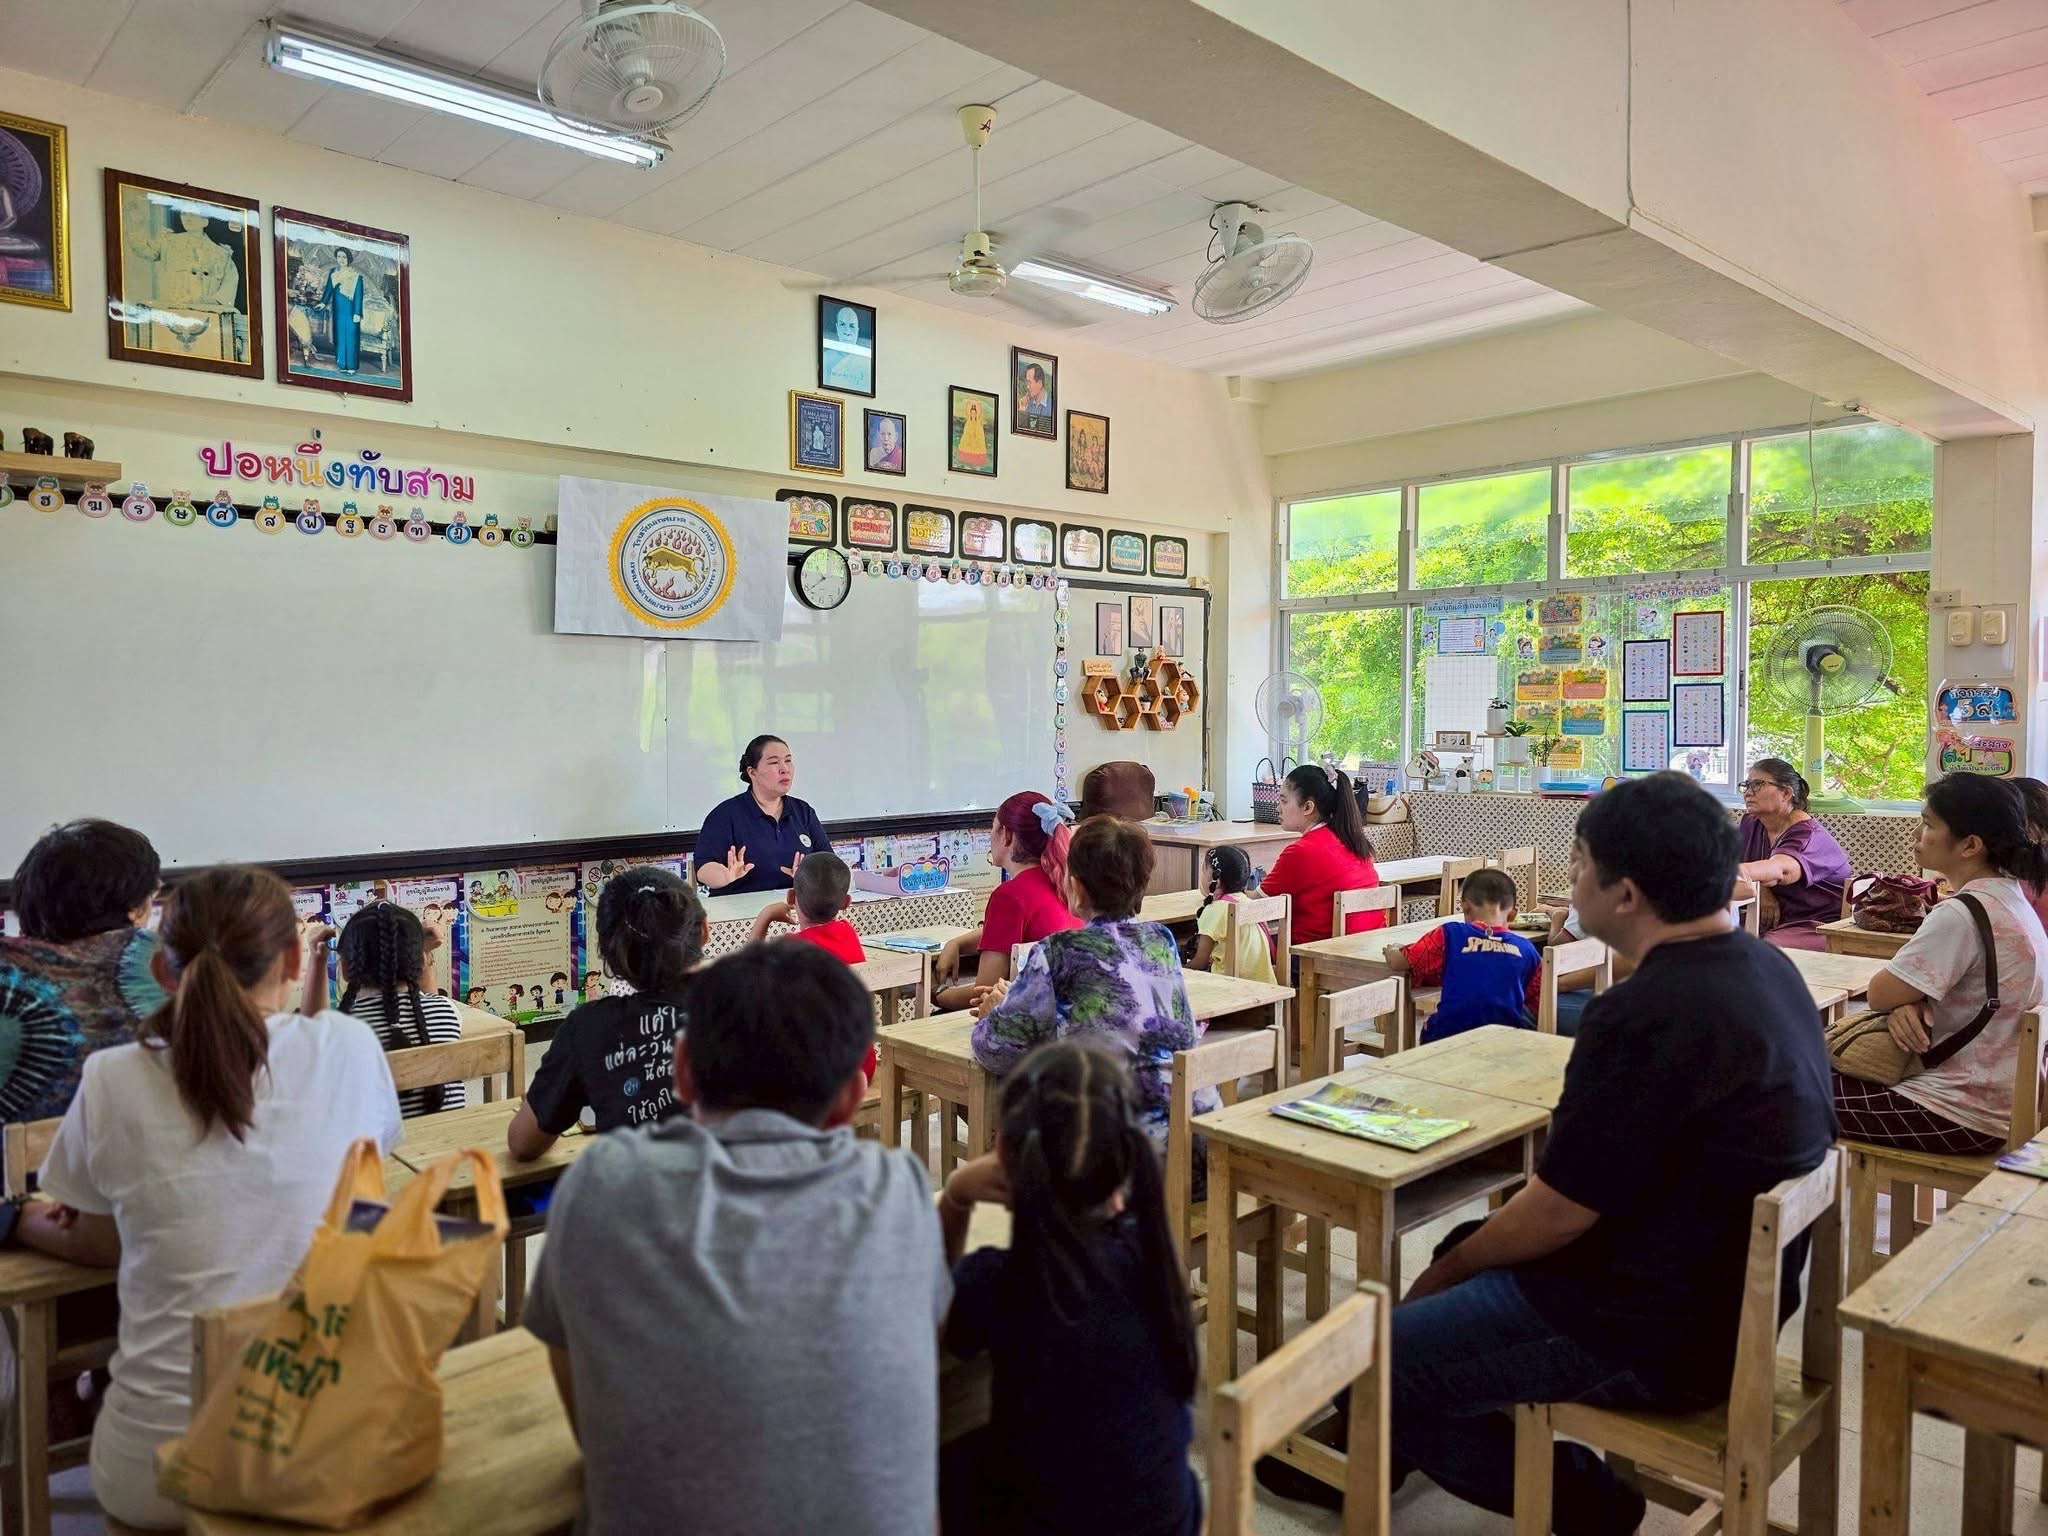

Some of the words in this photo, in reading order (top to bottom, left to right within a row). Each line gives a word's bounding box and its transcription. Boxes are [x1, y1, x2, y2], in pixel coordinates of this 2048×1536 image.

[200, 428, 475, 503] ปอหนึ่งทับสาม
[134, 504, 145, 516] ร
[216, 509, 229, 521] ศ
[264, 515, 276, 527] ส
[1949, 687, 2001, 699] กิจกรรม
